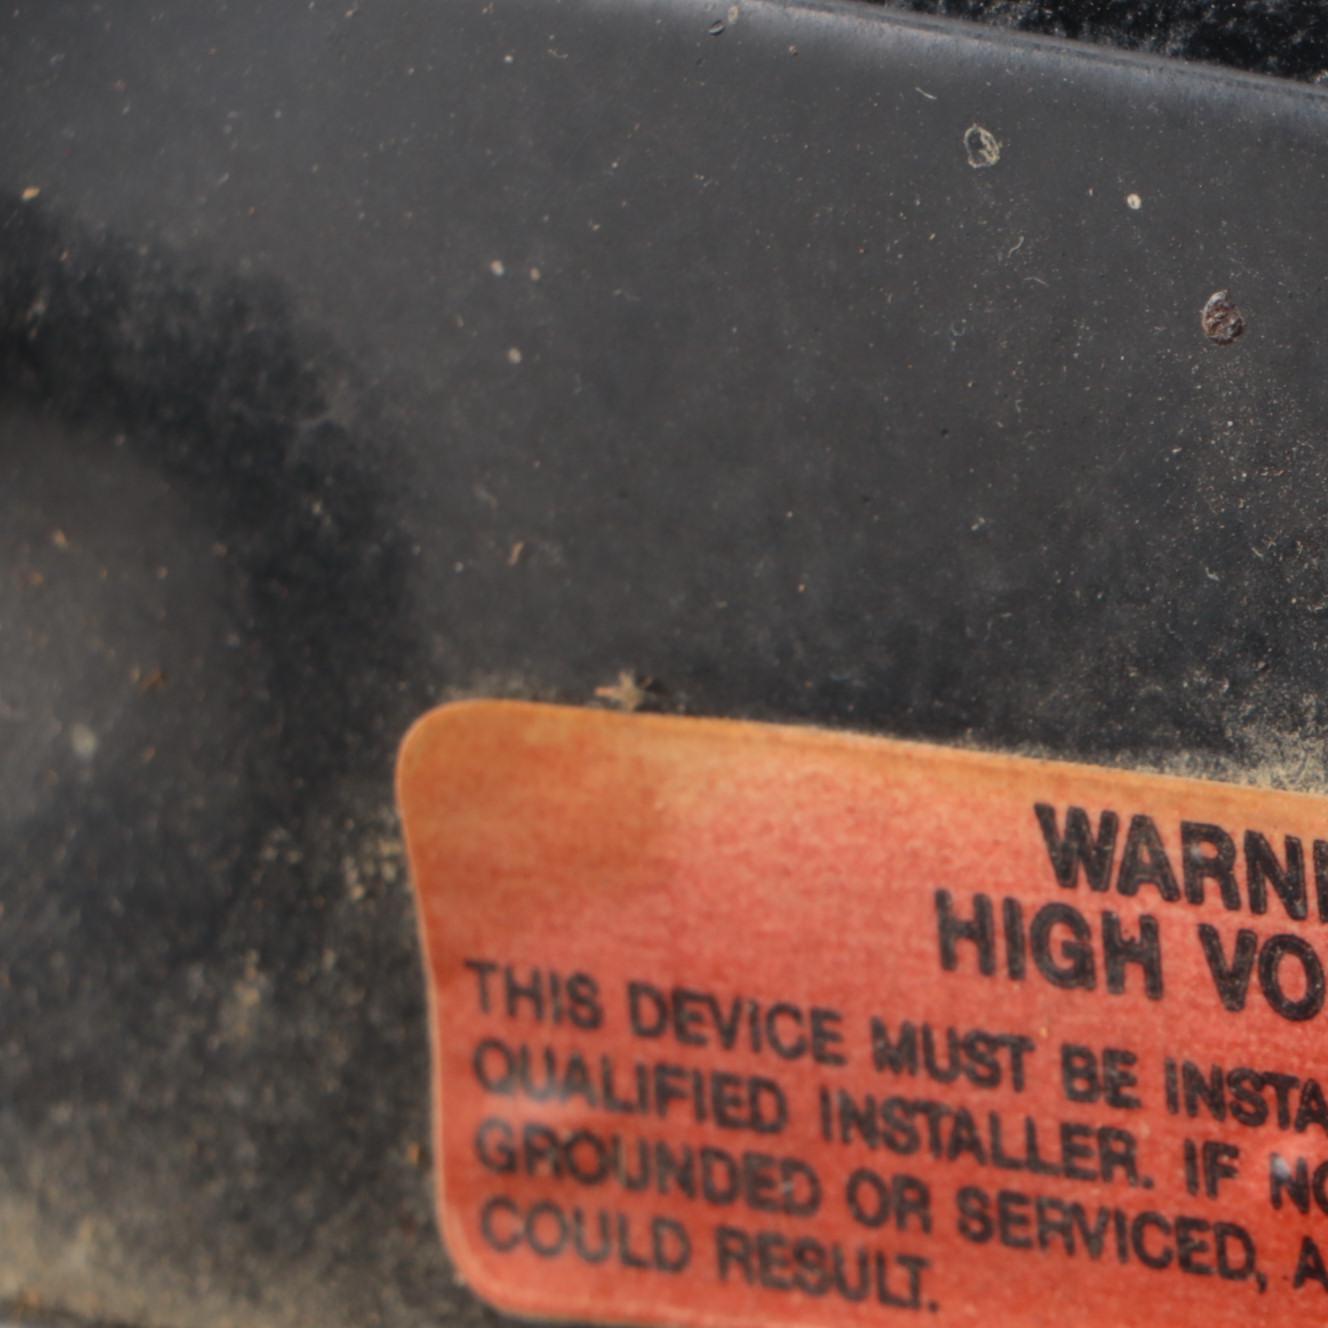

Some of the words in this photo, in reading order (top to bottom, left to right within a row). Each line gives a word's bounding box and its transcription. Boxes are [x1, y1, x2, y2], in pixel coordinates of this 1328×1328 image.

[933, 887, 1165, 1001] HIGH
[463, 958, 603, 1029] THIS
[627, 980, 845, 1066] DEVICE
[870, 1017, 1036, 1091] MUST
[1060, 1042, 1141, 1109] BE
[469, 1038, 788, 1134] QUALIFIED
[820, 1089, 1154, 1189] INSTALLER.
[1183, 1138, 1240, 1199] IF
[472, 1125, 820, 1214] GROUNDED
[847, 1168, 932, 1234] OR
[957, 1186, 1269, 1294] SERVICED,
[478, 1195, 691, 1273] COULD
[716, 1226, 939, 1313] RESULT.
